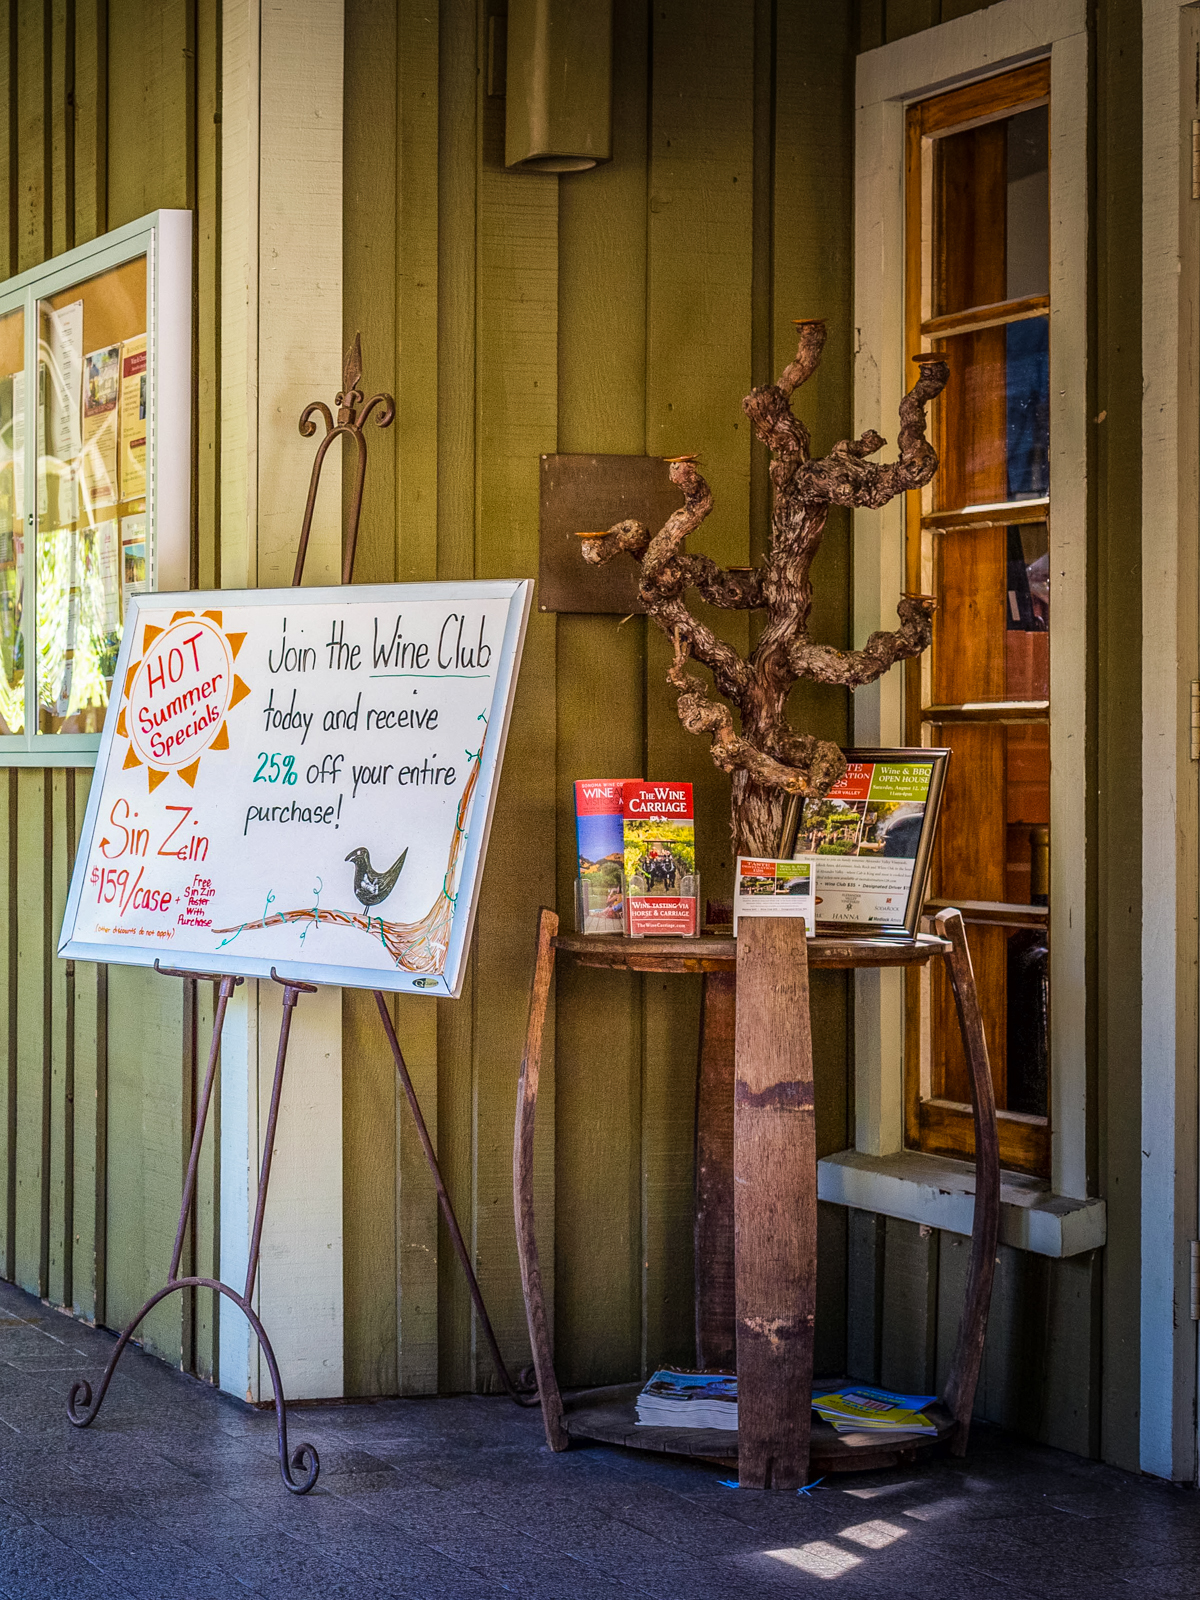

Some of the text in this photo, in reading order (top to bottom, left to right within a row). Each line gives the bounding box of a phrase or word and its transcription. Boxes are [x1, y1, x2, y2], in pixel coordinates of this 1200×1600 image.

[268, 613, 492, 674] Join the Wine Club
[146, 630, 203, 699] HOT
[138, 673, 223, 734] Summer
[263, 688, 439, 746] today and receive
[150, 703, 220, 758] Specials
[252, 751, 457, 798] 25% off your entire
[881, 767, 900, 775] Wine
[912, 768, 932, 776] BBQ
[833, 780, 848, 788] 28
[902, 776, 929, 784] HOUSE
[582, 787, 613, 798] WINE
[629, 798, 687, 812] CARRIAGE
[243, 793, 344, 837] purchase!
[98, 797, 209, 862] Sin Zin
[192, 873, 212, 888] Free
[89, 864, 172, 918] $159/case
[183, 885, 216, 898] Sin Zin
[187, 897, 210, 906] Poster
[186, 907, 205, 916] With
[177, 914, 213, 928] Purchase
[112, 925, 137, 935] discounts
[139, 926, 146, 935] do
[146, 928, 155, 936] not
